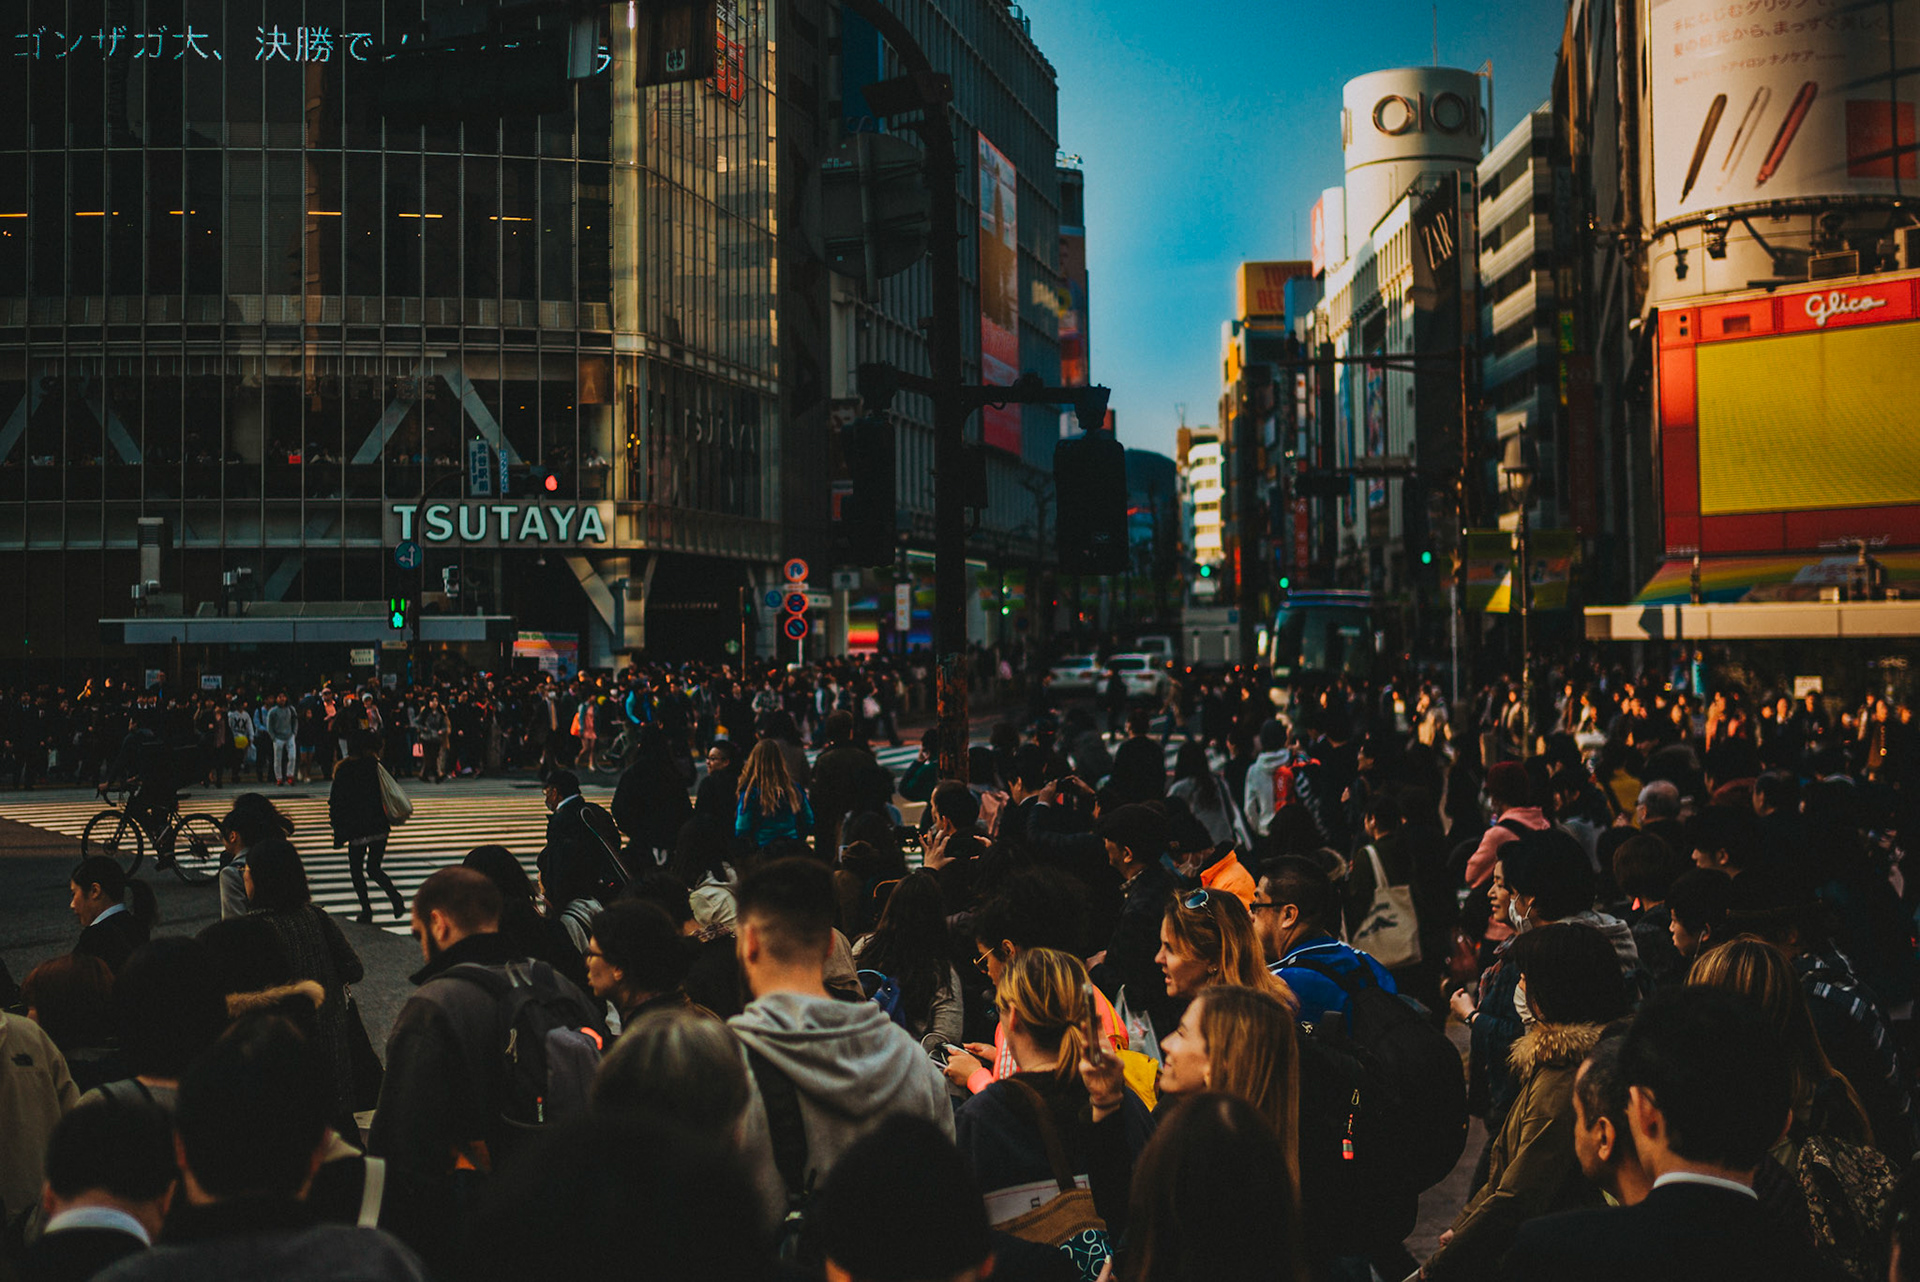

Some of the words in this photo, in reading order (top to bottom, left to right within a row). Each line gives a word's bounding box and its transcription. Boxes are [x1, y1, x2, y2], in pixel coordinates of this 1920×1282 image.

[14, 25, 222, 60] ゴンザガ大、
[1421, 208, 1453, 271] ZAR
[1805, 291, 1887, 326] Glico
[392, 505, 606, 541] TSUTAYA
